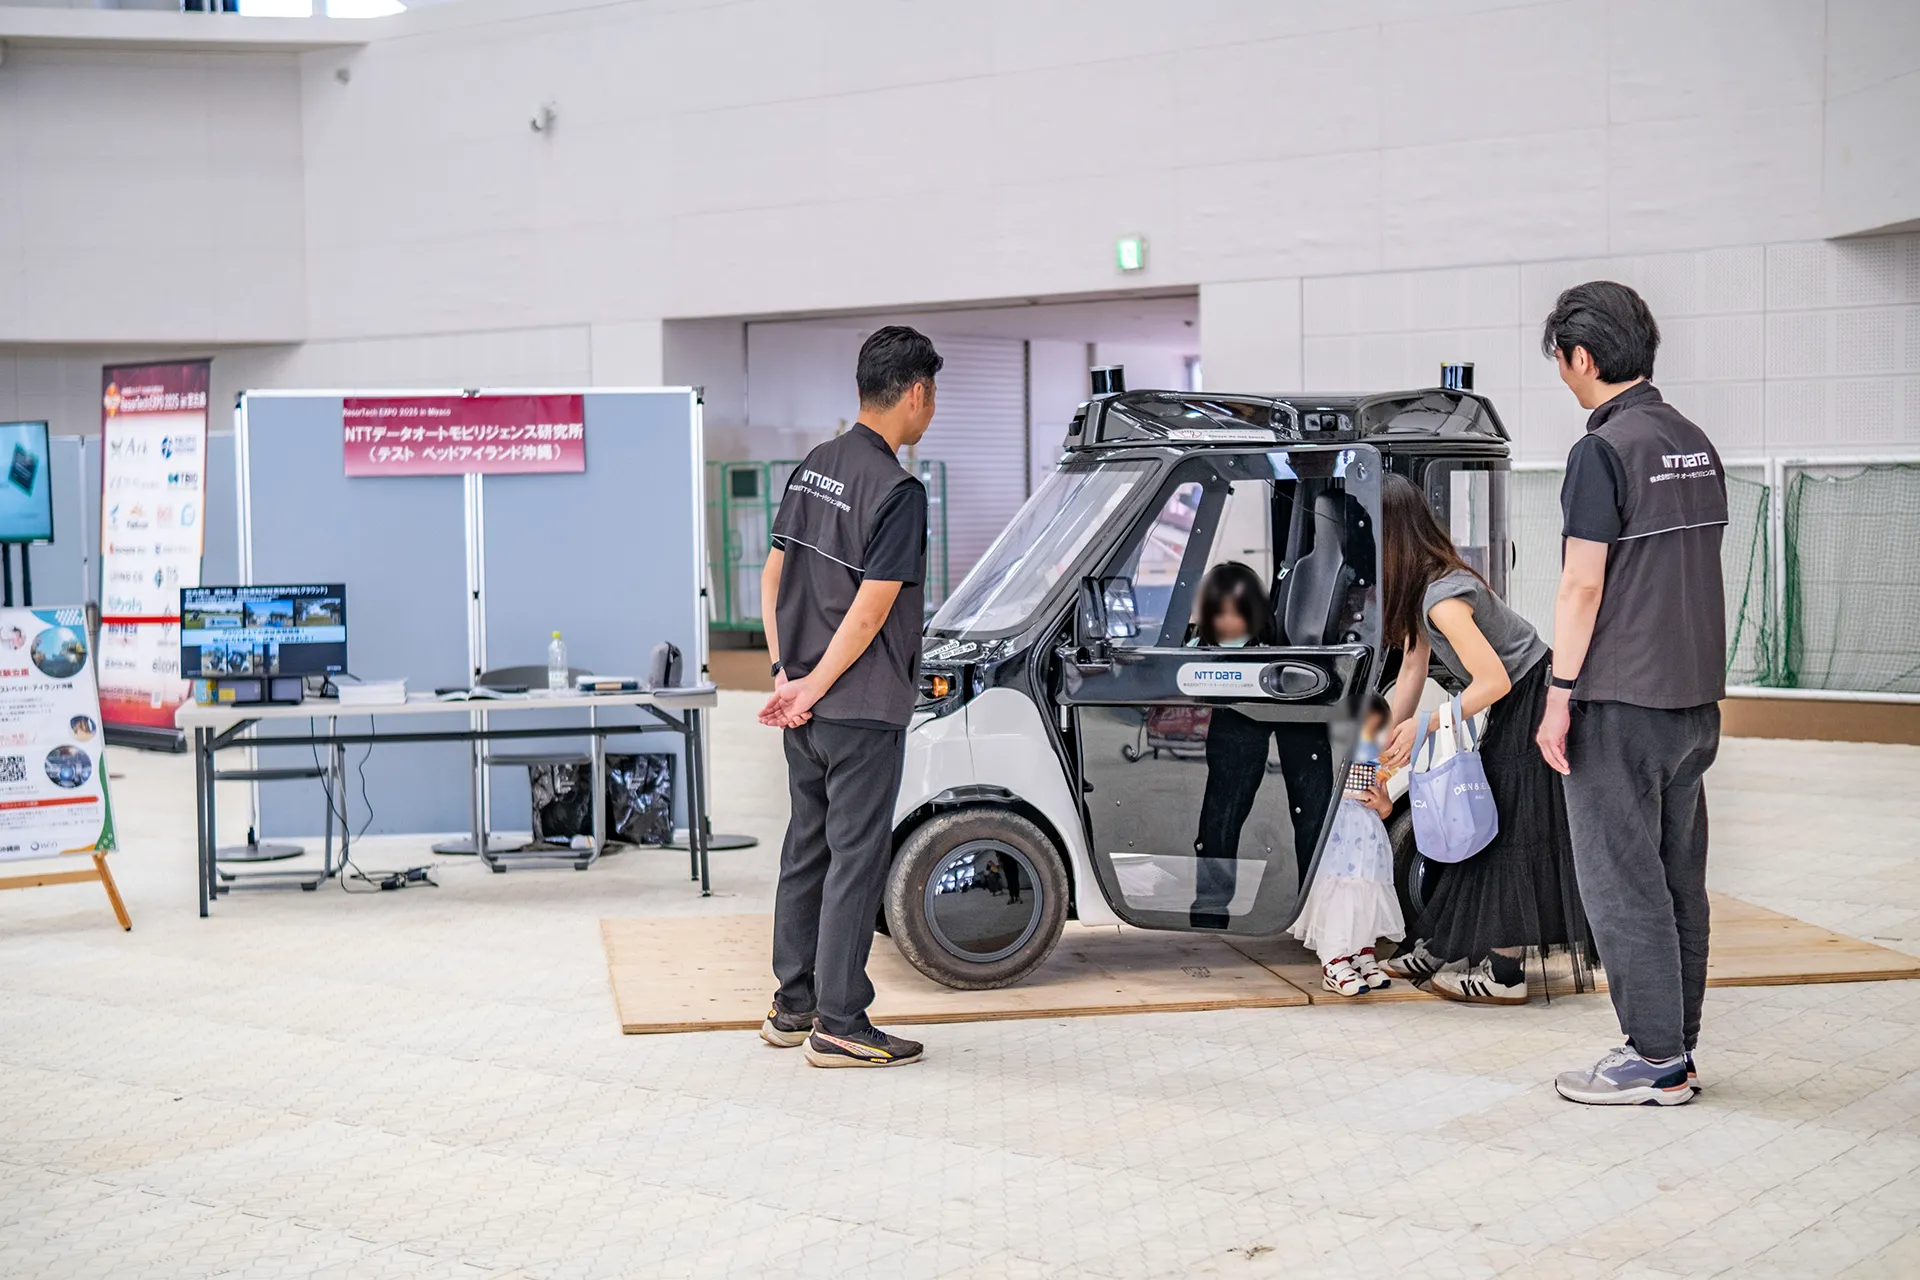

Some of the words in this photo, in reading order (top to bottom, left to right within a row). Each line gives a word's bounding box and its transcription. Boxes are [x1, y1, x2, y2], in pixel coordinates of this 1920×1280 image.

[378, 407, 397, 417] EXPO
[399, 408, 418, 417] 2025
[345, 423, 583, 443] NTTデータオートモビリジェンス研究所
[1194, 671, 1214, 680] NTT
